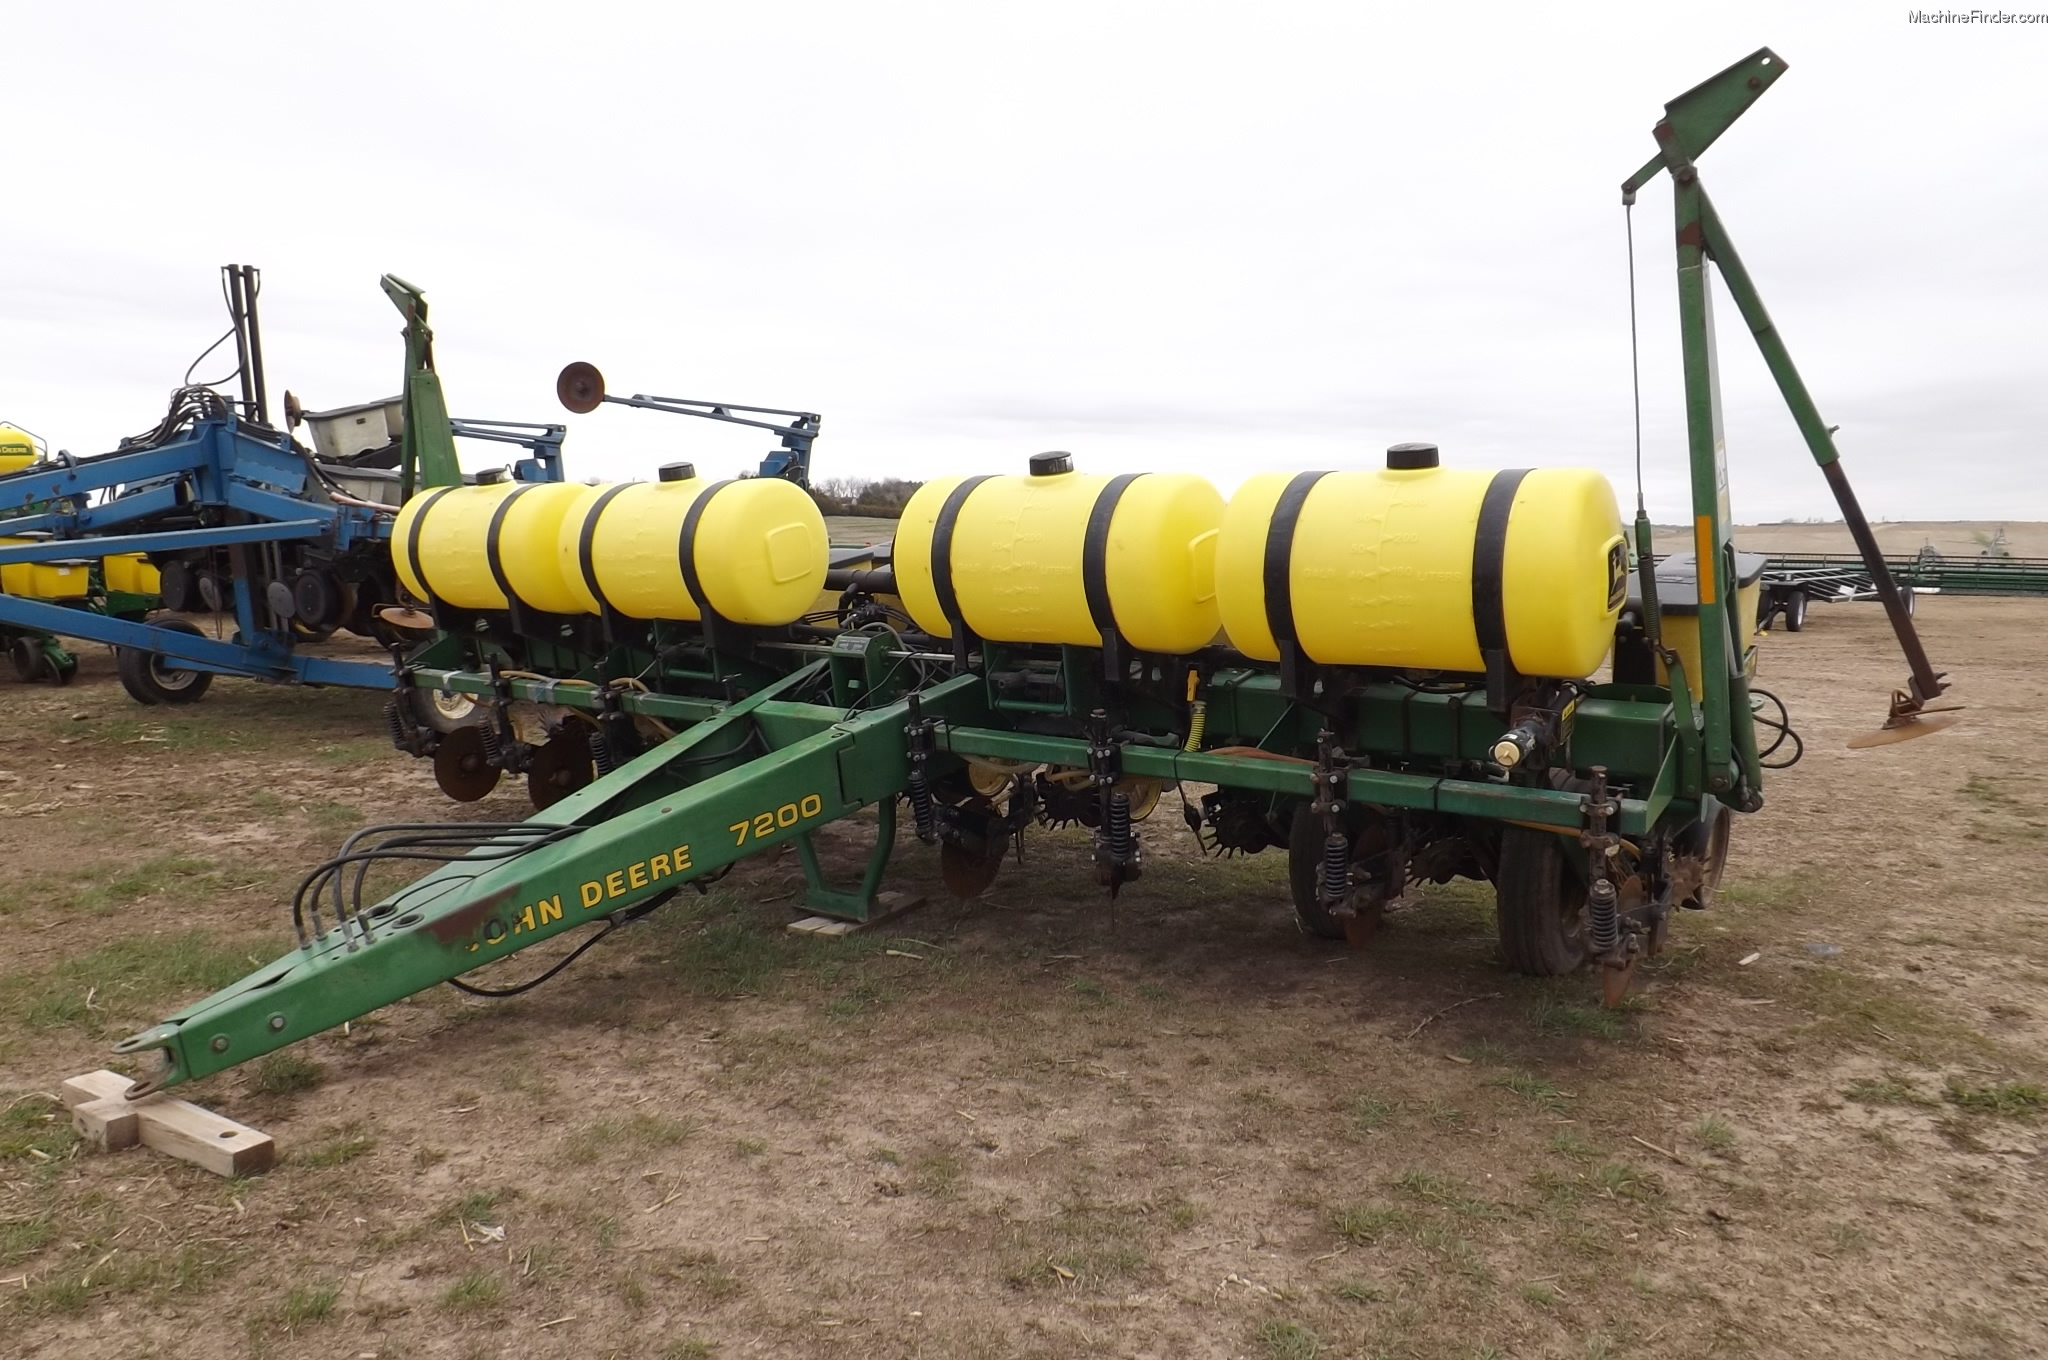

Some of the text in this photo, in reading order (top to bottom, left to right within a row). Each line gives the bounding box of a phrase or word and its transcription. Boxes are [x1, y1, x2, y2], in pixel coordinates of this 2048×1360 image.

[1394, 532, 1419, 544] 200
[1351, 543, 1366, 555] 50
[1416, 571, 1463, 583] LITERS
[465, 793, 823, 952] OHN DEERE 7200
